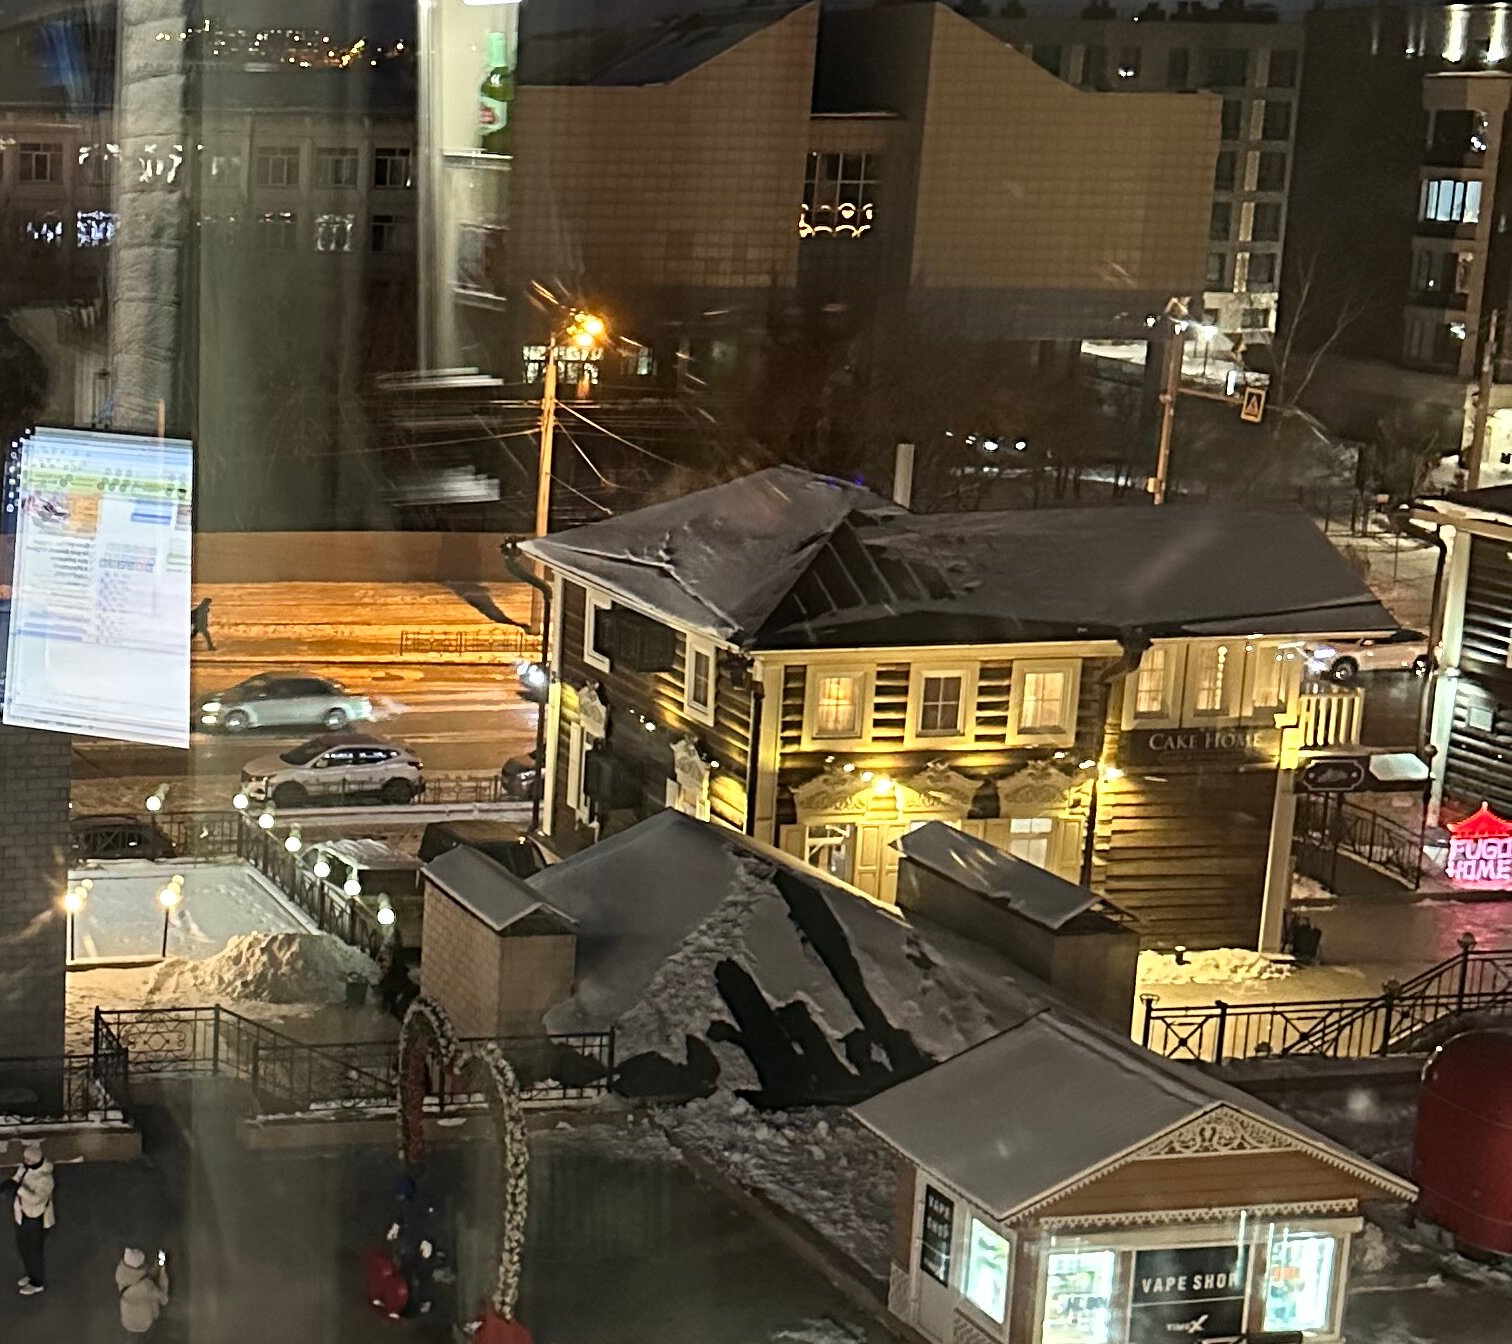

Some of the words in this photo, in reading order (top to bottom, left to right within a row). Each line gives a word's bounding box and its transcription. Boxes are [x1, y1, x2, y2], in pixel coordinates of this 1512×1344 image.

[1149, 733, 1198, 751] CAKE
[1204, 732, 1263, 750] HOME
[1445, 858, 1511, 881] HOME
[1141, 1276, 1188, 1294] VAPE
